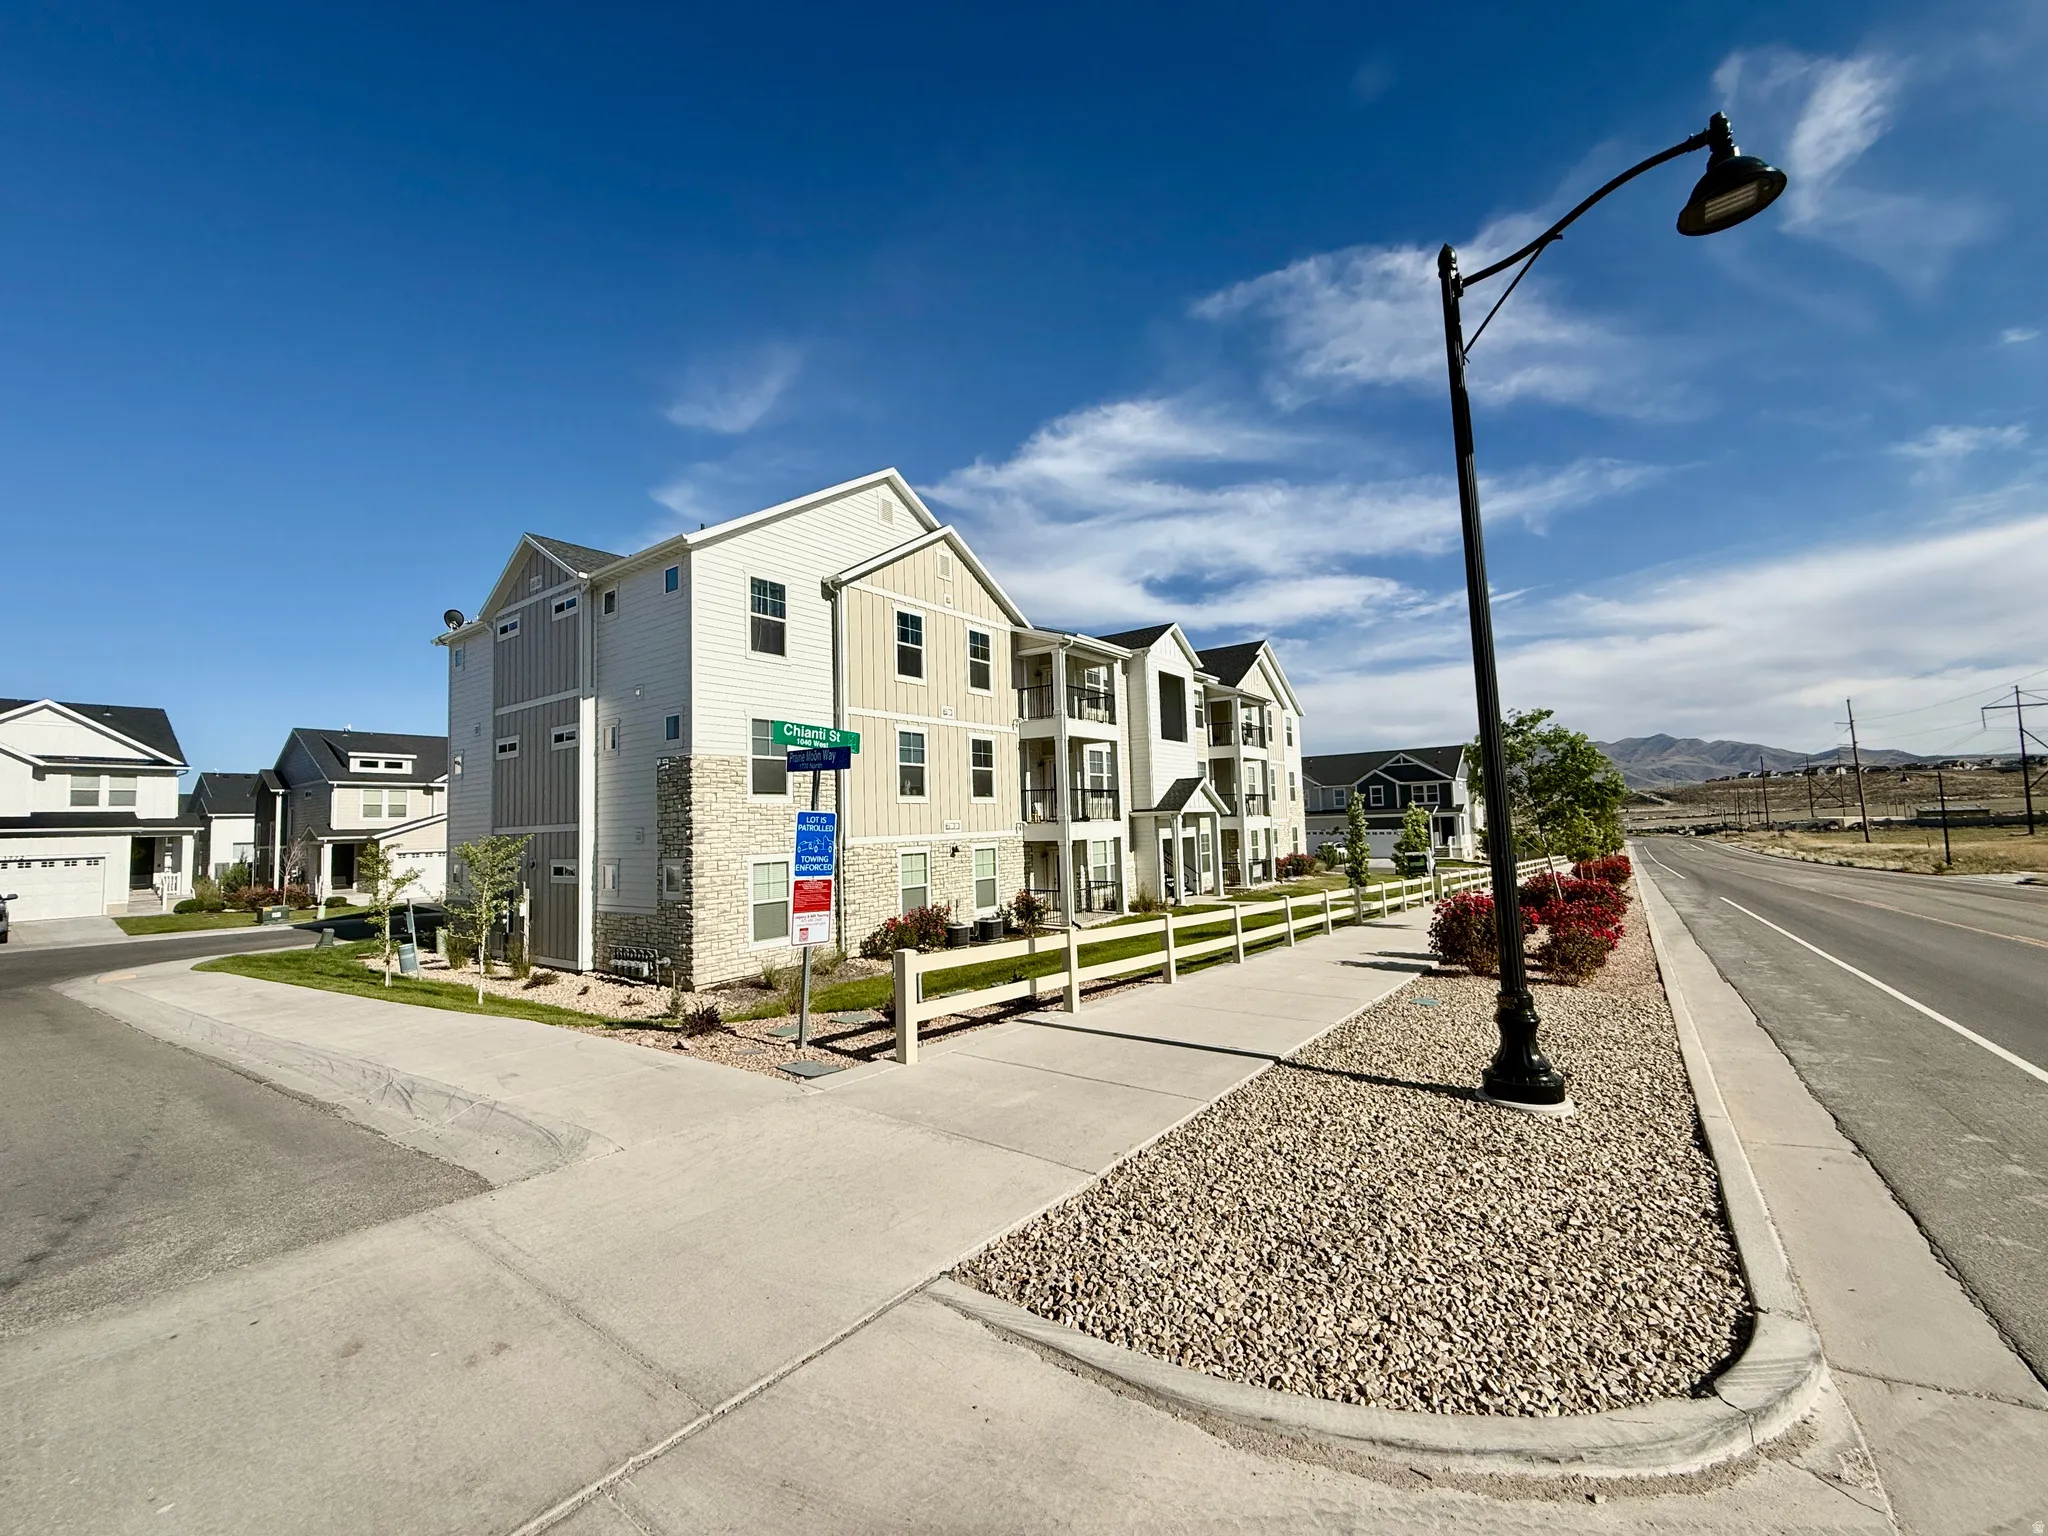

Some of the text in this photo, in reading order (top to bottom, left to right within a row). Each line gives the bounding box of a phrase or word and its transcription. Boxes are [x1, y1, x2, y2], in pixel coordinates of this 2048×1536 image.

[783, 723, 841, 742] Chianti St
[797, 738, 829, 748] 1040 West
[789, 749, 836, 763] Prairie Moon Way
[806, 816, 827, 824] LOT IS
[798, 823, 834, 832] PATROLLED
[801, 855, 829, 863] TOWING
[795, 863, 833, 872] ENFORCED
